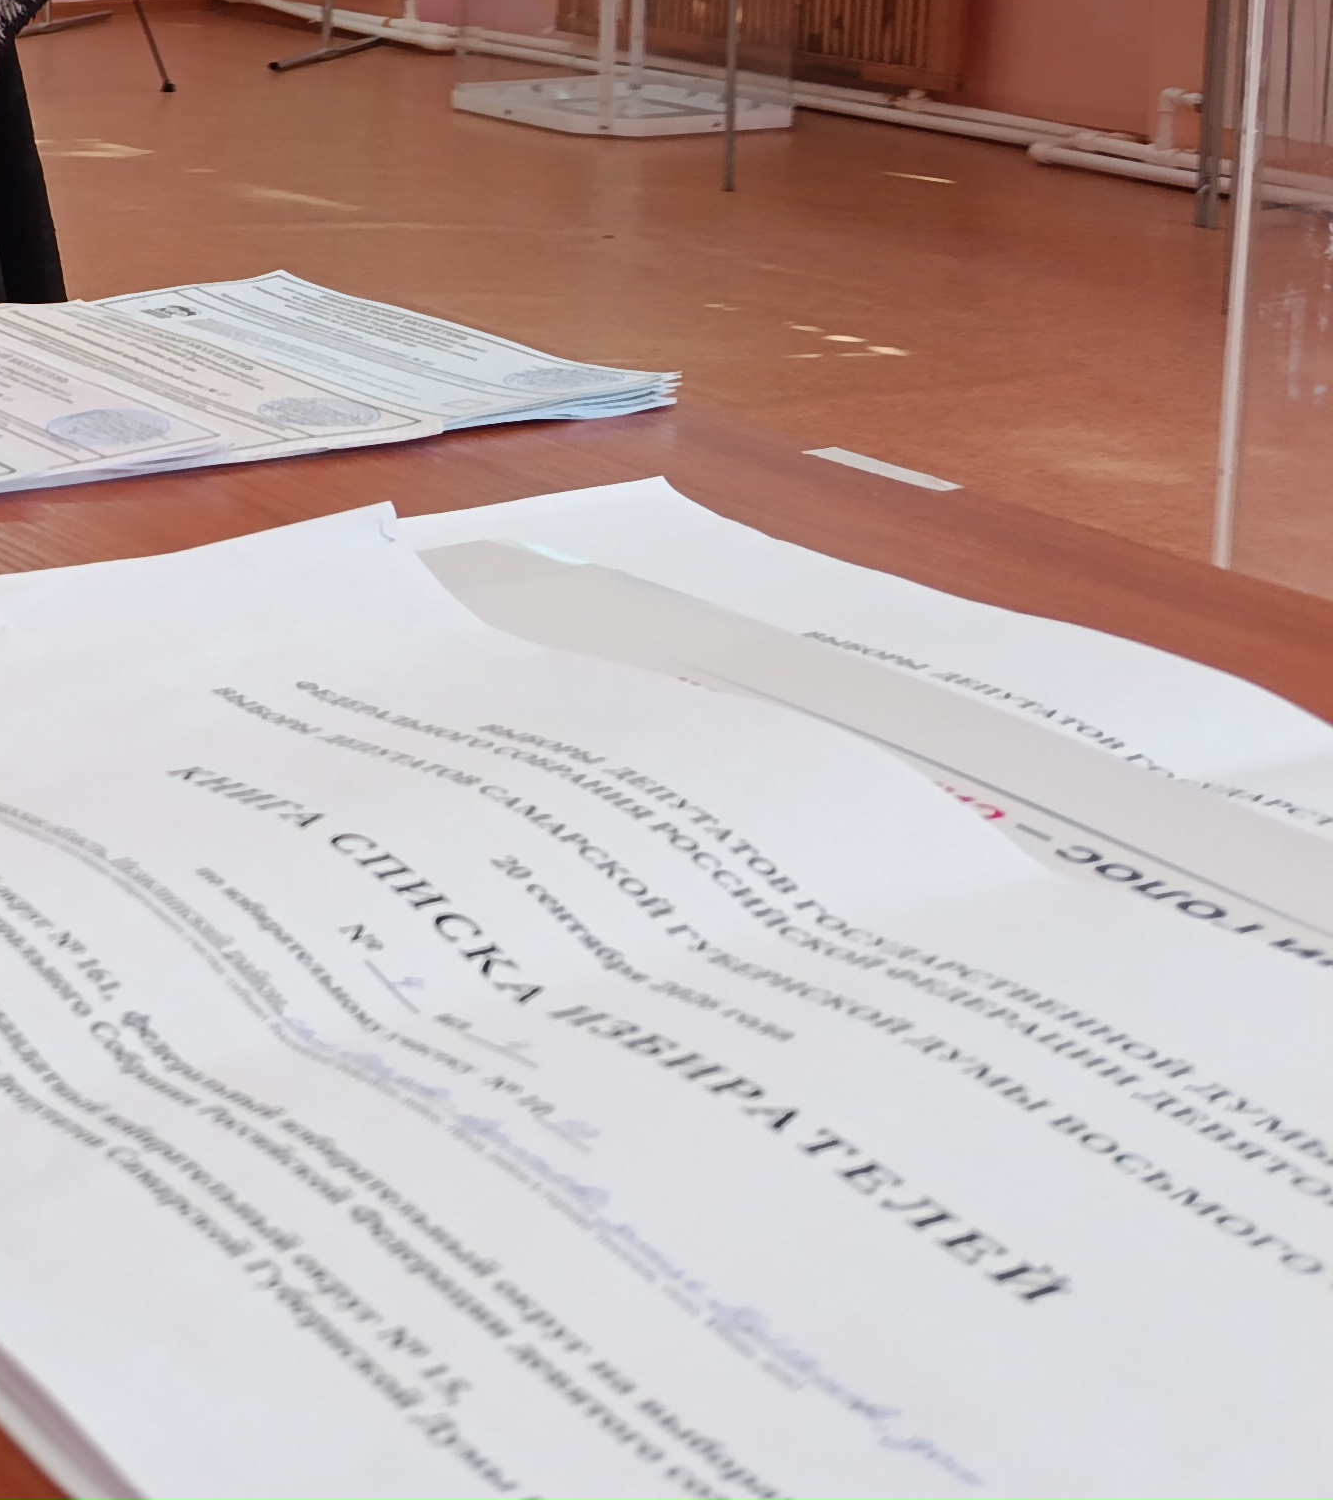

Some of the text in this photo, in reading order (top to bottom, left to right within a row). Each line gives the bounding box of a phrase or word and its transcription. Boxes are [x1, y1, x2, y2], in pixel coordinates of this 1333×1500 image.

[801, 629, 930, 671] ВЫБОРЫ
[927, 670, 1125, 751] ДЕПУТАТОВ
[164, 765, 326, 831] КНИГА
[328, 832, 546, 1005] СПИСКА
[545, 1002, 1070, 1303] ИЗБИРАТЕЛЕЙ
[211, 686, 1326, 1276] ВЫБОРЫ ДЕПУТАТОВ САМАРСКОЙ ГУБЕРНСКОЙ ДУМЫ ВОСЬМОГО
[222, 885, 383, 1034] избирательному
[480, 1075, 525, 1097] №
[295, 679, 1333, 1207] ФЕДЕРАЛЬНОГО СОБРАНИЯ РОССИЙСКОЙ ФЕДЕРАЦИИ ДЕВЯТО
[339, 923, 385, 950] №
[477, 722, 607, 765] ВЫБОРЫ
[600, 765, 800, 895] ДЕПУТАТОВ
[793, 897, 1196, 1080] ГОСУДАРСТВЕННОЙ
[490, 853, 533, 881] 20
[524, 881, 650, 983] сентября
[47, 929, 89, 955] №
[76, 956, 123, 1003] 161,
[277, 1116, 503, 1278] избирательный
[491, 1276, 593, 1354] округ
[587, 1358, 638, 1396] на
[89, 1020, 203, 1108] Собрания
[196, 1102, 356, 1205] Российской
[348, 1200, 514, 1341] Федерации
[502, 1344, 668, 1464] девятого
[100, 1111, 304, 1252] избирательный
[290, 1251, 384, 1325] округ
[376, 1324, 432, 1359] №
[419, 1361, 474, 1407] 15,
[104, 1144, 257, 1260] Самарской
[241, 1256, 428, 1411] Губернской
[405, 1411, 520, 1494] Думы
